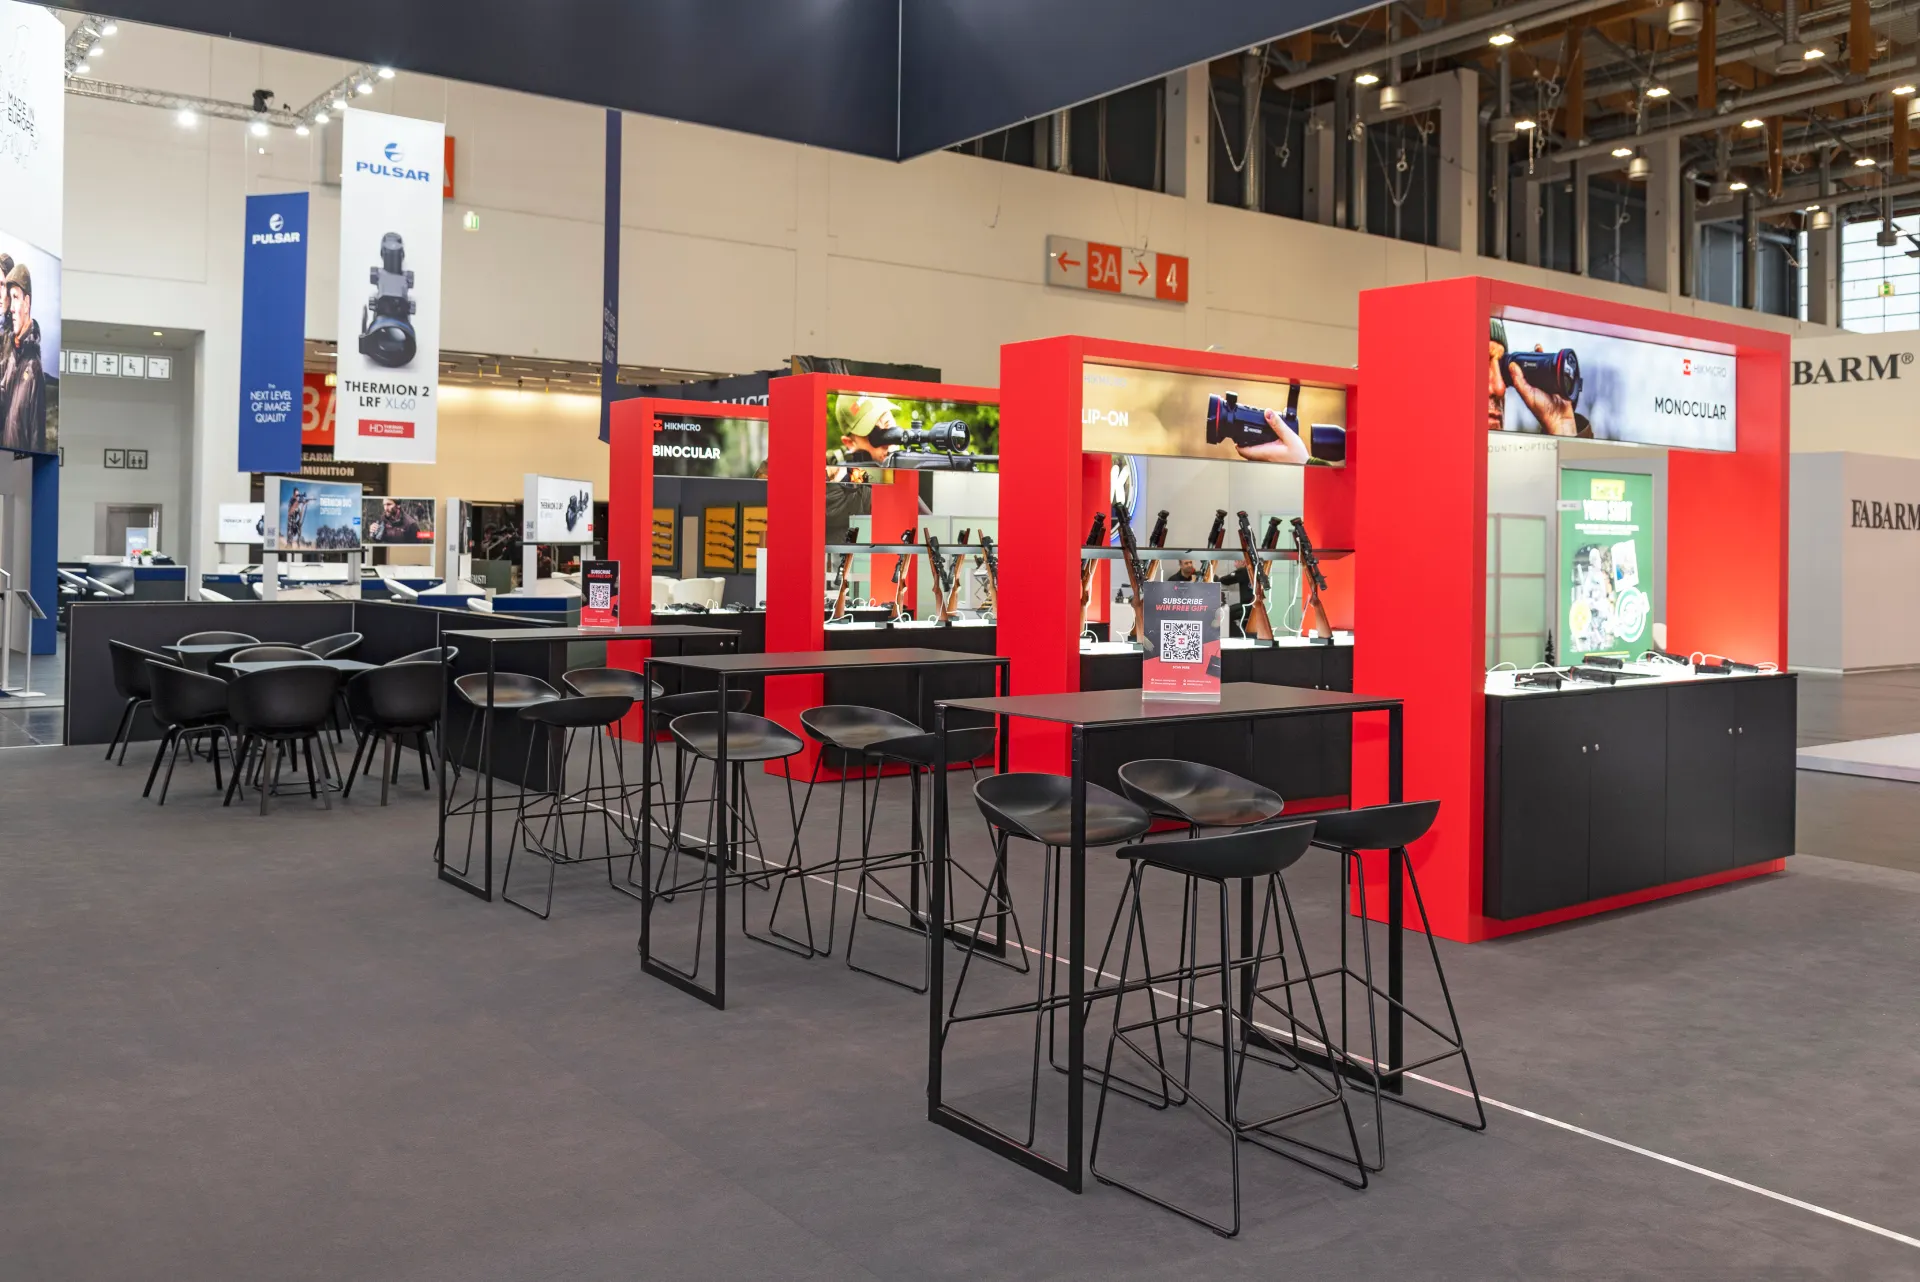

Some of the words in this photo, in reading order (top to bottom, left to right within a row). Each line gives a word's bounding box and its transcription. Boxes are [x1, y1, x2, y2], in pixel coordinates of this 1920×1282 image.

[8, 91, 27, 116] MADE
[8, 106, 35, 138] EUROPE
[356, 161, 430, 182] PULSAR
[252, 231, 301, 245] PULSAR
[1091, 250, 1120, 285] 3A
[1166, 262, 1178, 294] 4
[1694, 364, 1727, 378] HIKMICRO
[250, 390, 269, 401] NEXT
[270, 389, 292, 401] LEVEL
[345, 380, 418, 396] THERMION
[421, 385, 430, 397] 2
[251, 401, 263, 412] OF
[264, 401, 292, 412] IMAGE
[359, 396, 381, 408] LRF
[385, 397, 416, 411] XL60
[1654, 396, 1727, 420] MONOCULAR
[255, 412, 287, 424] QUALITY
[369, 422, 383, 433] HD
[664, 421, 701, 432] HIKMICRO
[652, 444, 720, 459] BINOCULAR
[1851, 499, 1920, 531] FABARM
[1162, 597, 1203, 605] SUBSCRIBE
